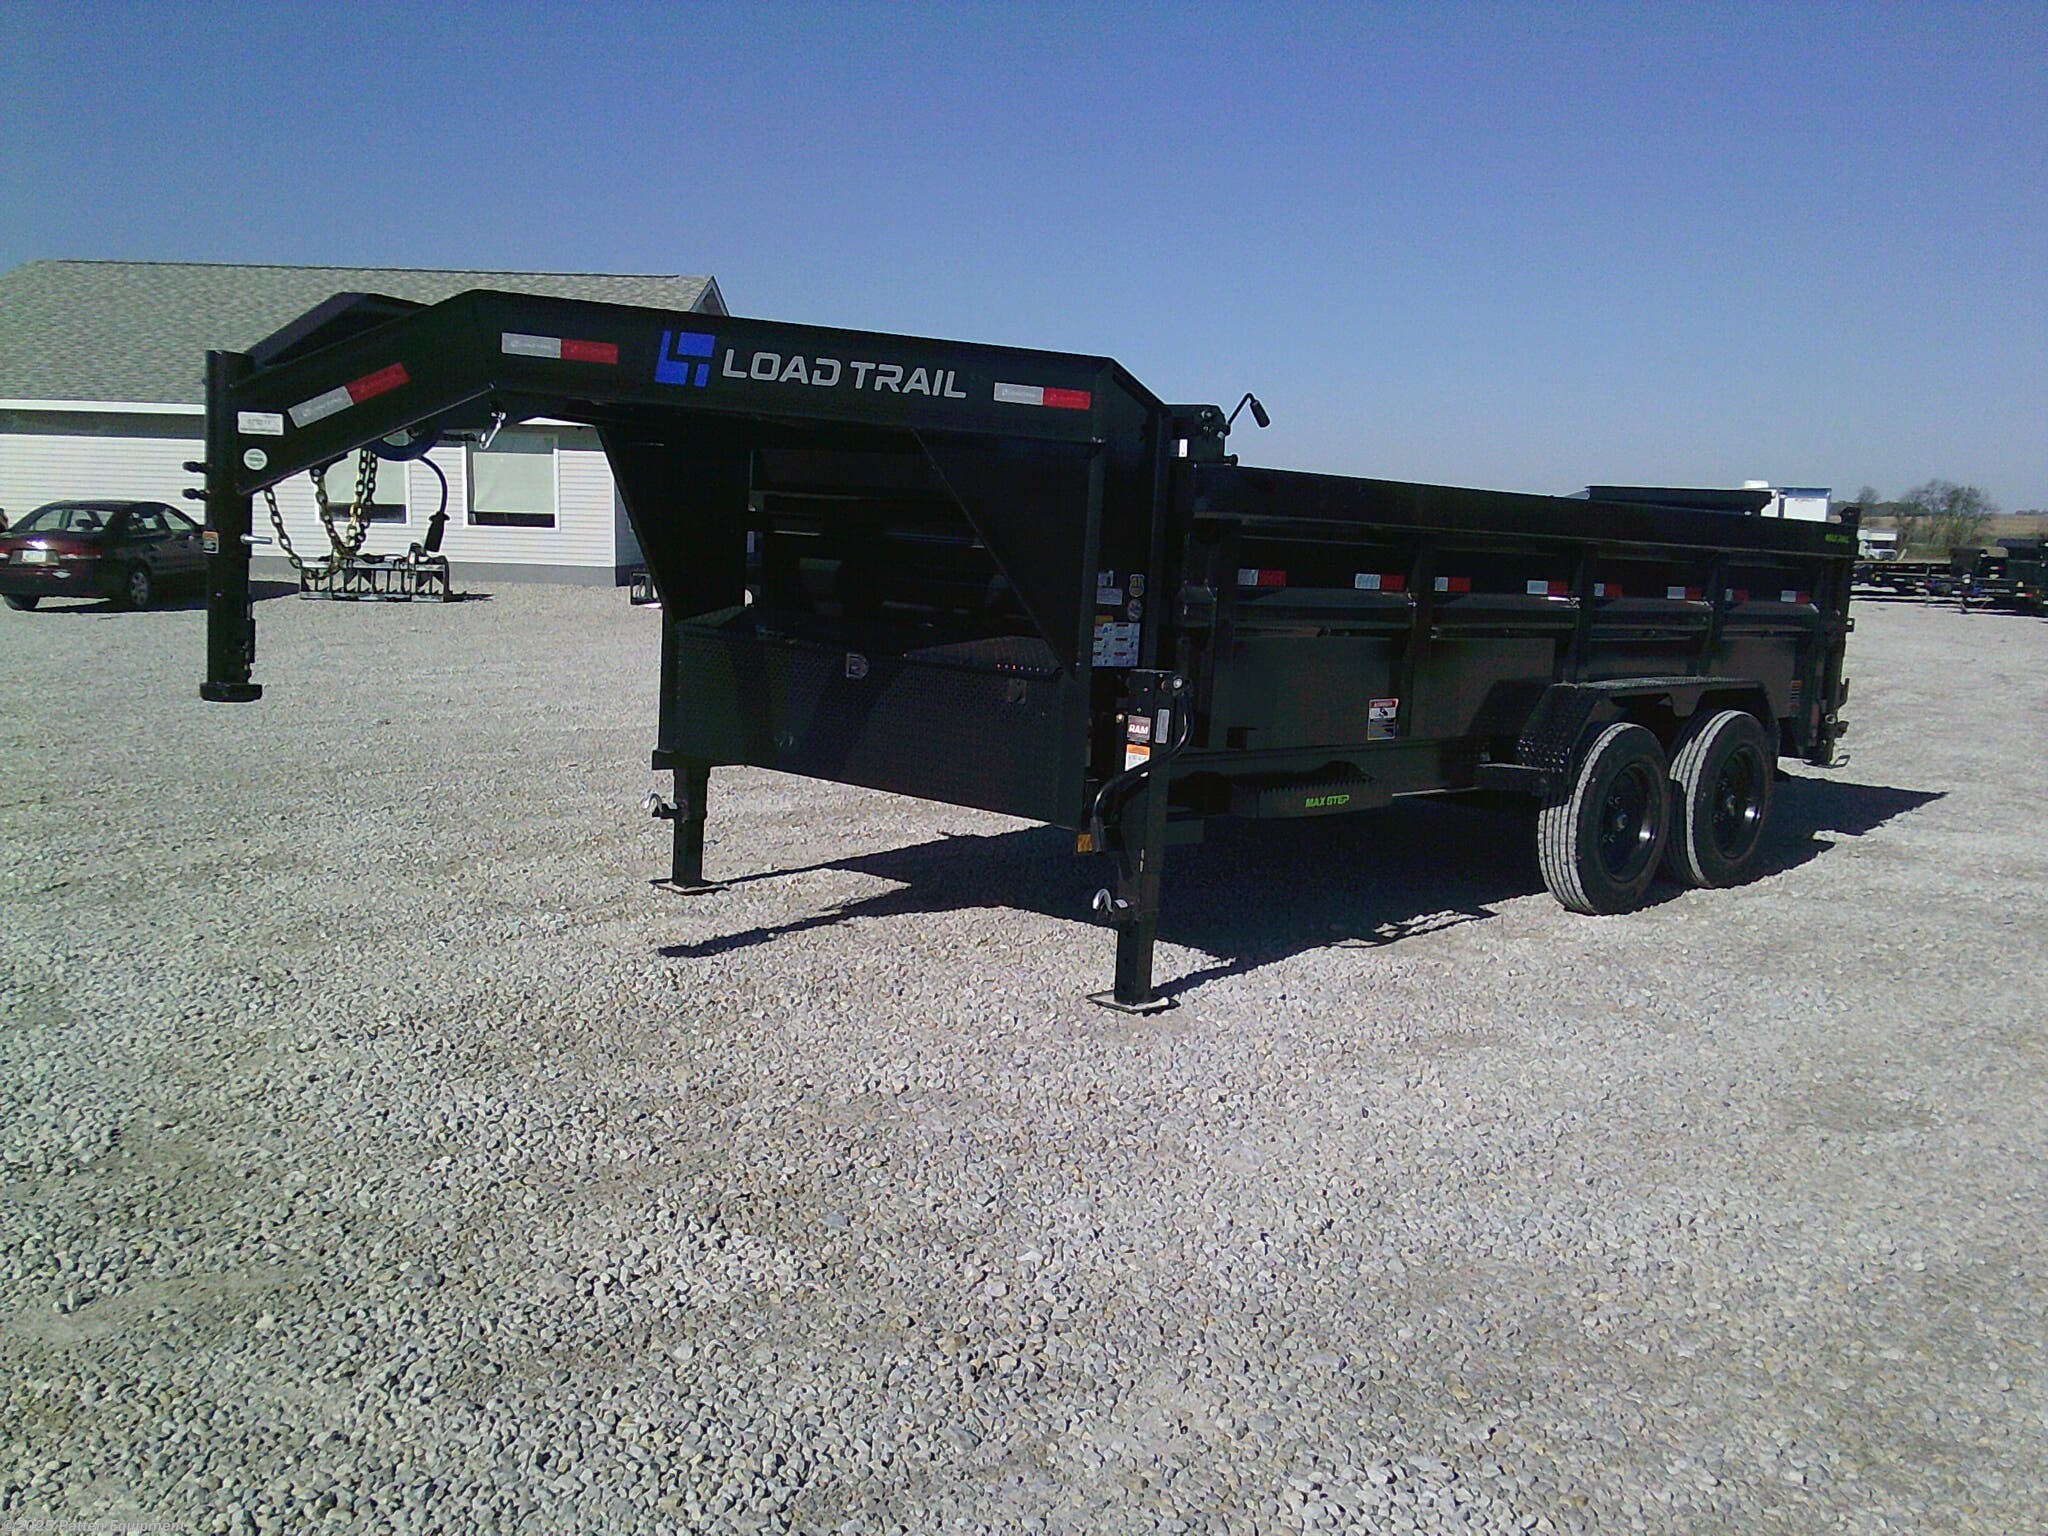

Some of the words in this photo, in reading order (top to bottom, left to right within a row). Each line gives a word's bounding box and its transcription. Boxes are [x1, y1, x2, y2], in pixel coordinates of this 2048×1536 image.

[721, 348, 842, 388] LOAD
[849, 360, 968, 399] TRAIL
[1128, 723, 1150, 735] RAM
[1305, 796, 1325, 808] MAX
